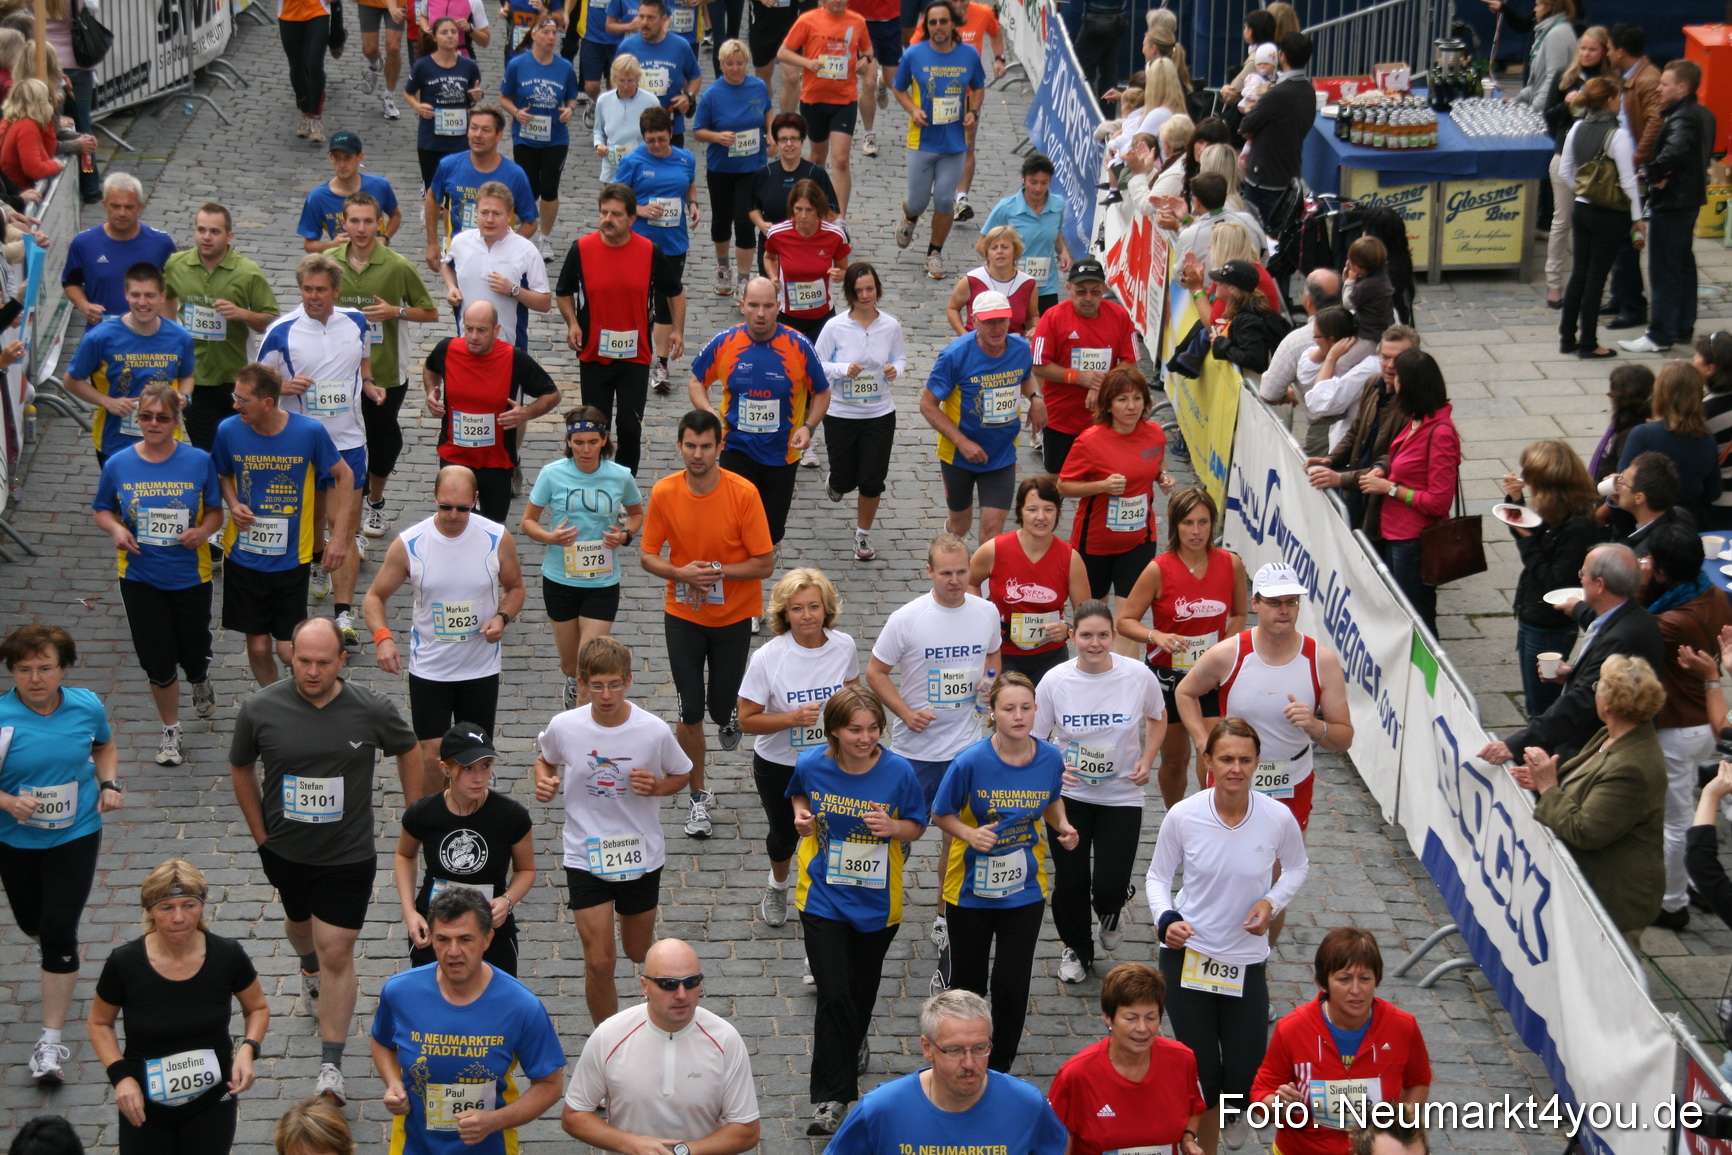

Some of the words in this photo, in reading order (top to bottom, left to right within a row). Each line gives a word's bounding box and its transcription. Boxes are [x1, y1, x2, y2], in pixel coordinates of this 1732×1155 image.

[829, 62, 844, 71] 715
[931, 66, 967, 74] NEUMARKTER
[648, 80, 664, 88] 653
[944, 108, 957, 116] 714
[444, 119, 464, 127] 3093
[528, 124, 548, 133] 3094
[738, 139, 757, 148] 2466
[1446, 184, 1524, 224] Glossner
[1484, 205, 1520, 222] Bier
[1456, 242, 1506, 254] Biergenuss
[1028, 268, 1047, 277] 2273
[799, 290, 822, 300] 2689
[195, 309, 215, 318] Patrick
[196, 320, 222, 329] 3633
[611, 338, 634, 348] 6012
[114, 354, 125, 362] 10.
[126, 354, 178, 362] NEUMARKTER
[1082, 352, 1100, 360] Lorenz
[1082, 360, 1107, 371] 2302
[981, 369, 1023, 382] NEUMARKTER
[854, 382, 879, 393] 2893
[981, 376, 1018, 389] STADTLAUF
[320, 394, 347, 404] 6168
[749, 389, 771, 399] IMO
[995, 389, 1014, 399] Manfred
[748, 403, 768, 411] Jürgen
[996, 399, 1017, 411] 2907
[463, 416, 484, 424] Richard
[749, 411, 775, 422] 3749
[463, 425, 490, 436] 3282
[245, 455, 304, 463] NEUMARKTER
[243, 462, 292, 471] STADTLAUF
[123, 483, 133, 491] 10.
[135, 482, 194, 491] NEUMARKTER
[133, 489, 184, 497] STADTLAUF
[566, 487, 612, 513] run
[150, 512, 178, 521] Irmgard
[1121, 508, 1145, 519] 2342
[151, 521, 184, 534] 2078
[252, 530, 284, 544] 2077
[577, 544, 601, 553] Kristina
[582, 554, 605, 566] 378
[446, 605, 469, 613] Markus
[448, 614, 478, 629] 2623
[1024, 616, 1043, 624] Ulrike
[925, 646, 969, 659] PETER
[944, 682, 974, 696] 3051
[787, 687, 833, 703] PETER
[1063, 714, 1109, 727] PETER
[1080, 747, 1105, 759] Claudia
[1080, 760, 1114, 774] 2062
[1257, 764, 1276, 774] rank
[1255, 773, 1290, 787] 2066
[299, 781, 324, 791] Stefan
[36, 790, 58, 799] Maria
[811, 791, 822, 801] 10.
[977, 790, 989, 799] 10.
[991, 790, 1050, 800] NEUMARKTER
[300, 794, 336, 807] 3101
[989, 799, 1041, 808] STADTLAUF
[36, 800, 71, 814] 3001
[603, 838, 639, 850] Sebastian
[606, 850, 642, 868] 2148
[845, 859, 881, 873] 3807
[992, 860, 1005, 869] Tina
[992, 868, 1023, 884] 3723
[1200, 957, 1239, 980] 1039
[411, 1031, 423, 1043] 10.
[424, 1033, 504, 1046] NEUMARKTER
[421, 1045, 489, 1058] STADTLAUF
[166, 1057, 205, 1072] Josefine
[169, 1071, 215, 1093] 2059
[446, 1088, 465, 1098] Paul
[899, 1143, 916, 1155] 10.
[919, 1145, 1008, 1155] NEUMARKTER
